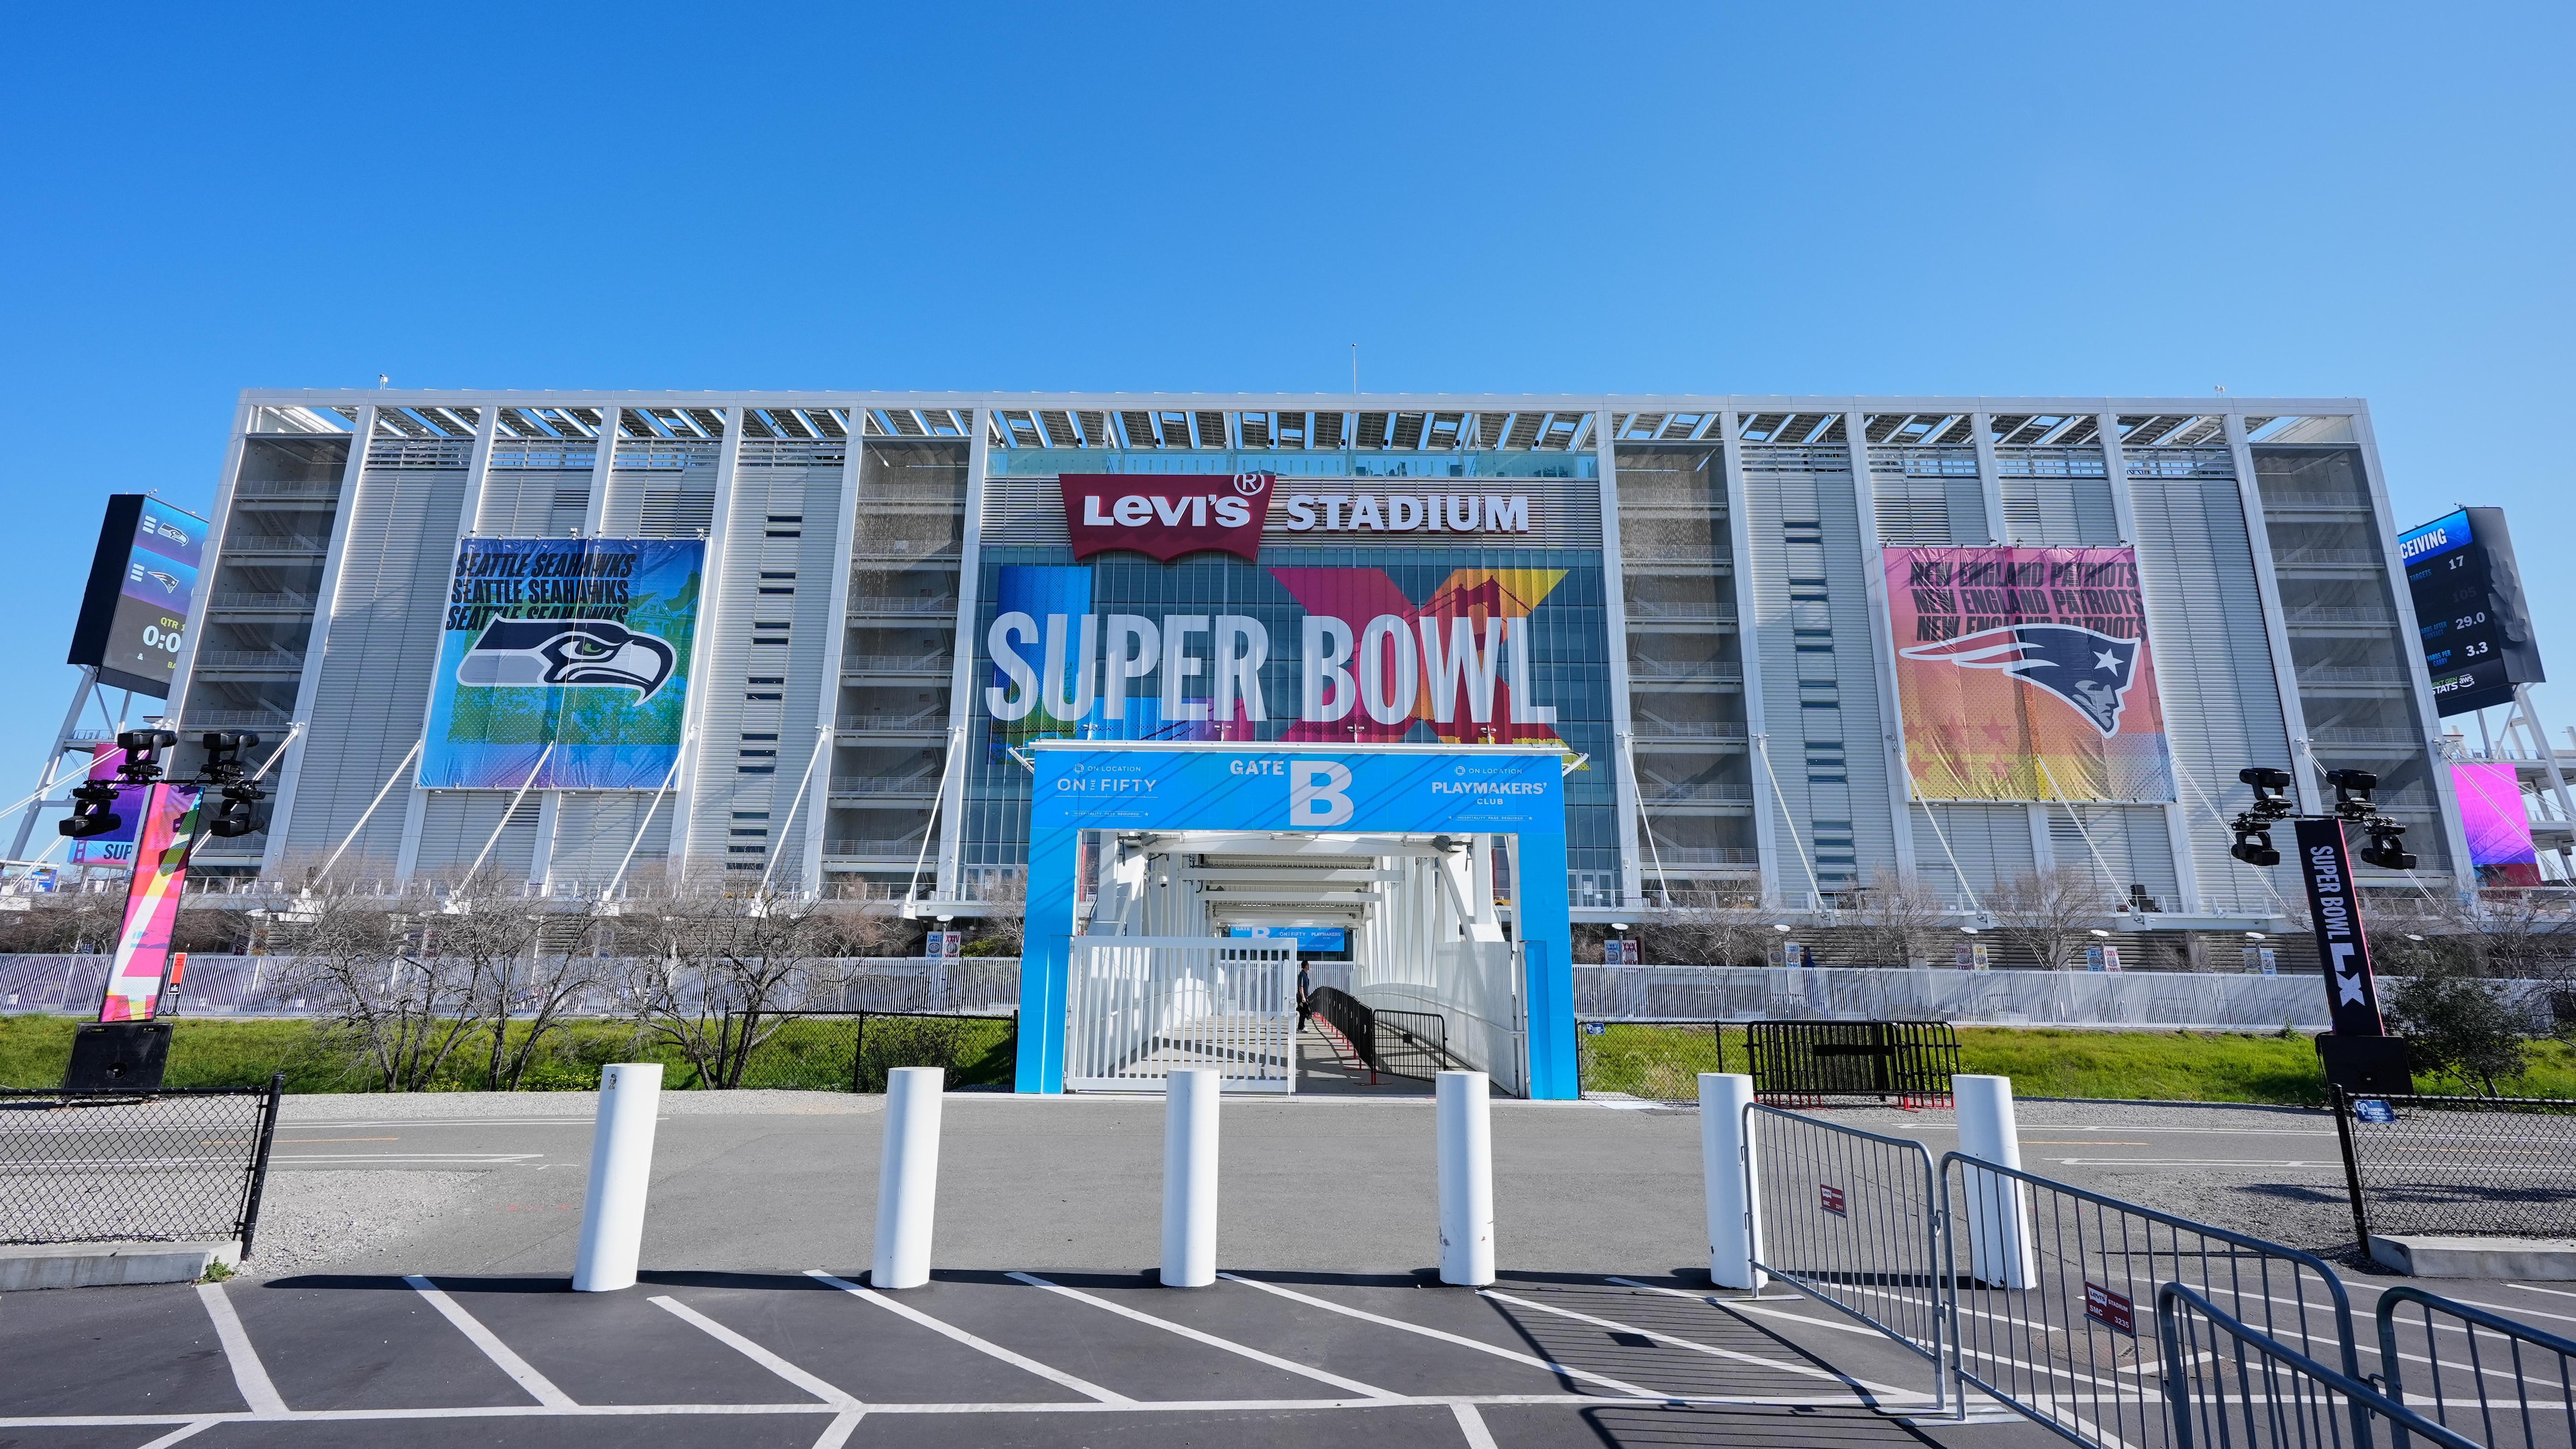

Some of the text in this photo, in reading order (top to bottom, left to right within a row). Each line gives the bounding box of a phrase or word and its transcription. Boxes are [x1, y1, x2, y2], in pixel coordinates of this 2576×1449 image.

[1287, 495, 1529, 533] STADIUM
[455, 553, 636, 577] SEATTLE SEAHAWKS
[2448, 555, 2464, 570] 17
[1910, 562, 2138, 587] NEW ENGLAND PATRIOTS
[2410, 569, 2432, 582] TARGETS
[451, 579, 629, 604] SEATTLE SEAHAWKS
[1911, 589, 2144, 615] NEW ENGLAND PATRIOTS
[160, 617, 178, 629] QTR
[1917, 616, 1960, 641] NEW
[2059, 617, 2147, 642] TRIOTS
[2434, 621, 2447, 630] AFTER
[2455, 612, 2485, 630] 29.0
[2424, 629, 2444, 640] CONTACT
[2427, 652, 2441, 661] YARDS
[2466, 641, 2488, 657] 3.3
[985, 611, 1557, 725] SUPER BOWL
[2433, 658, 2448, 667] CARRY
[1057, 778, 1086, 791] ON
[1101, 779, 1157, 792] FIFTY
[1230, 760, 1354, 826] GATE B
[1432, 782, 1547, 794] PLAYMAKERS'
[2310, 845, 2366, 1007] SUPER BOWL LX
[2108, 1299, 2128, 1312] STADIUM
[2090, 1305, 2129, 1329] SMC 3235
